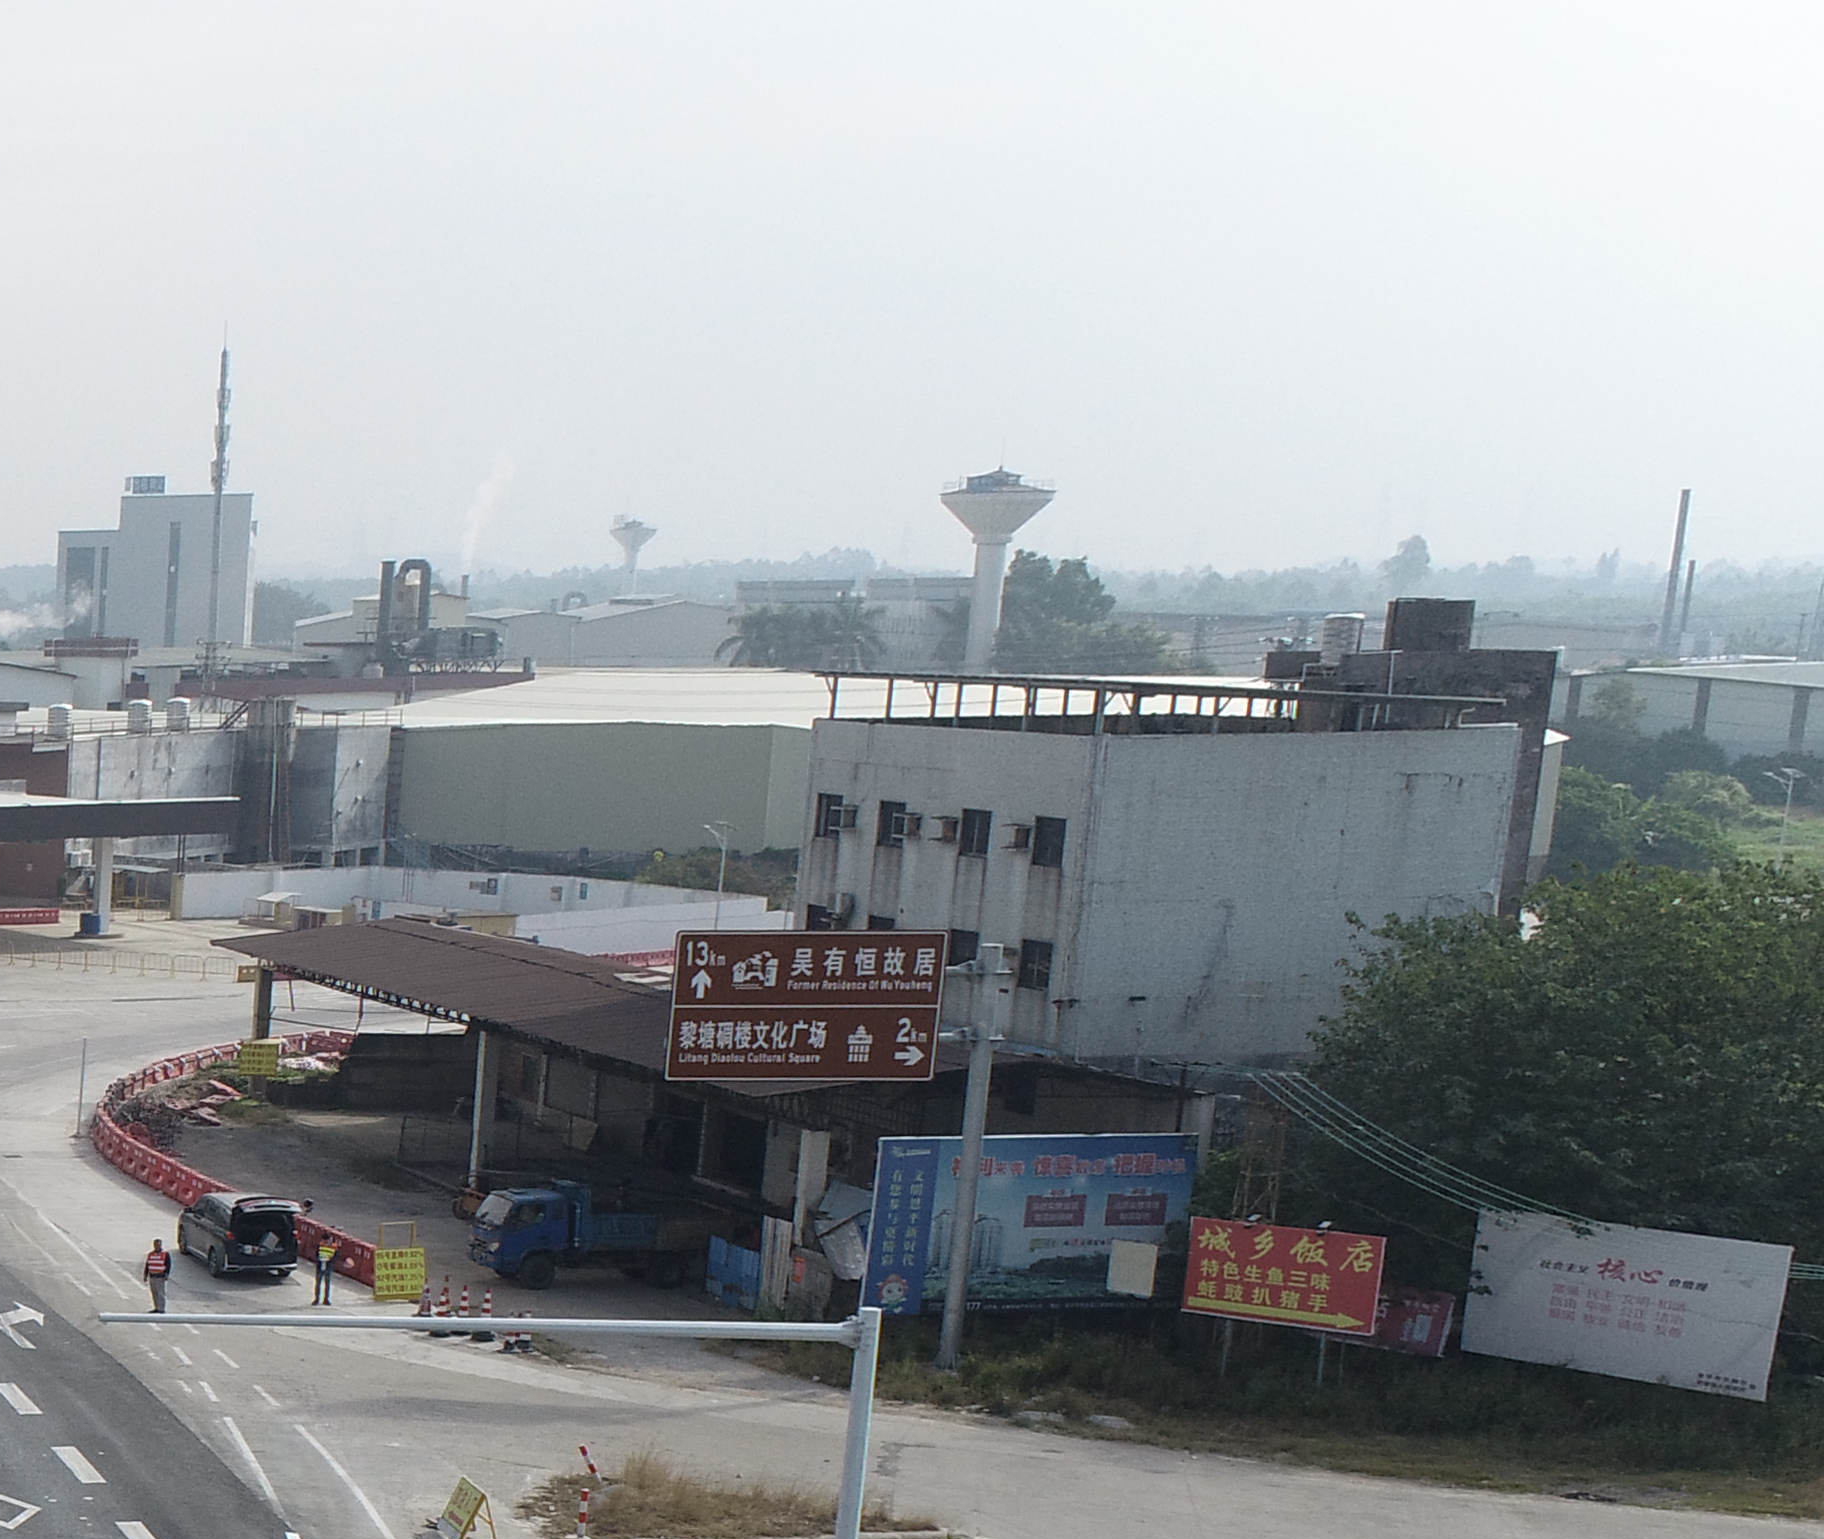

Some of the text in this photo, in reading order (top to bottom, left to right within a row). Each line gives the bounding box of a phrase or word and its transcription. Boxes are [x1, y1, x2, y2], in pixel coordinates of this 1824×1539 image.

[686, 941, 726, 966] 13km
[790, 947, 936, 977] 吴有恒故居
[787, 980, 820, 991] Former
[821, 980, 867, 991] Residence
[679, 1020, 828, 1050] 黎塘碉楼文化广场
[895, 1018, 928, 1044] 2km
[679, 1052, 821, 1066] Litang Diaolou Cultural Square
[881, 1168, 904, 1267] 有您参与更精彩
[1197, 1226, 1375, 1274] 城乡饭店
[1199, 1259, 1332, 1291] 特色生鱼三味
[1538, 1257, 1710, 1292] 社会主义 核心 价值观
[1196, 1280, 1328, 1312] 蚝豉扒猪手
